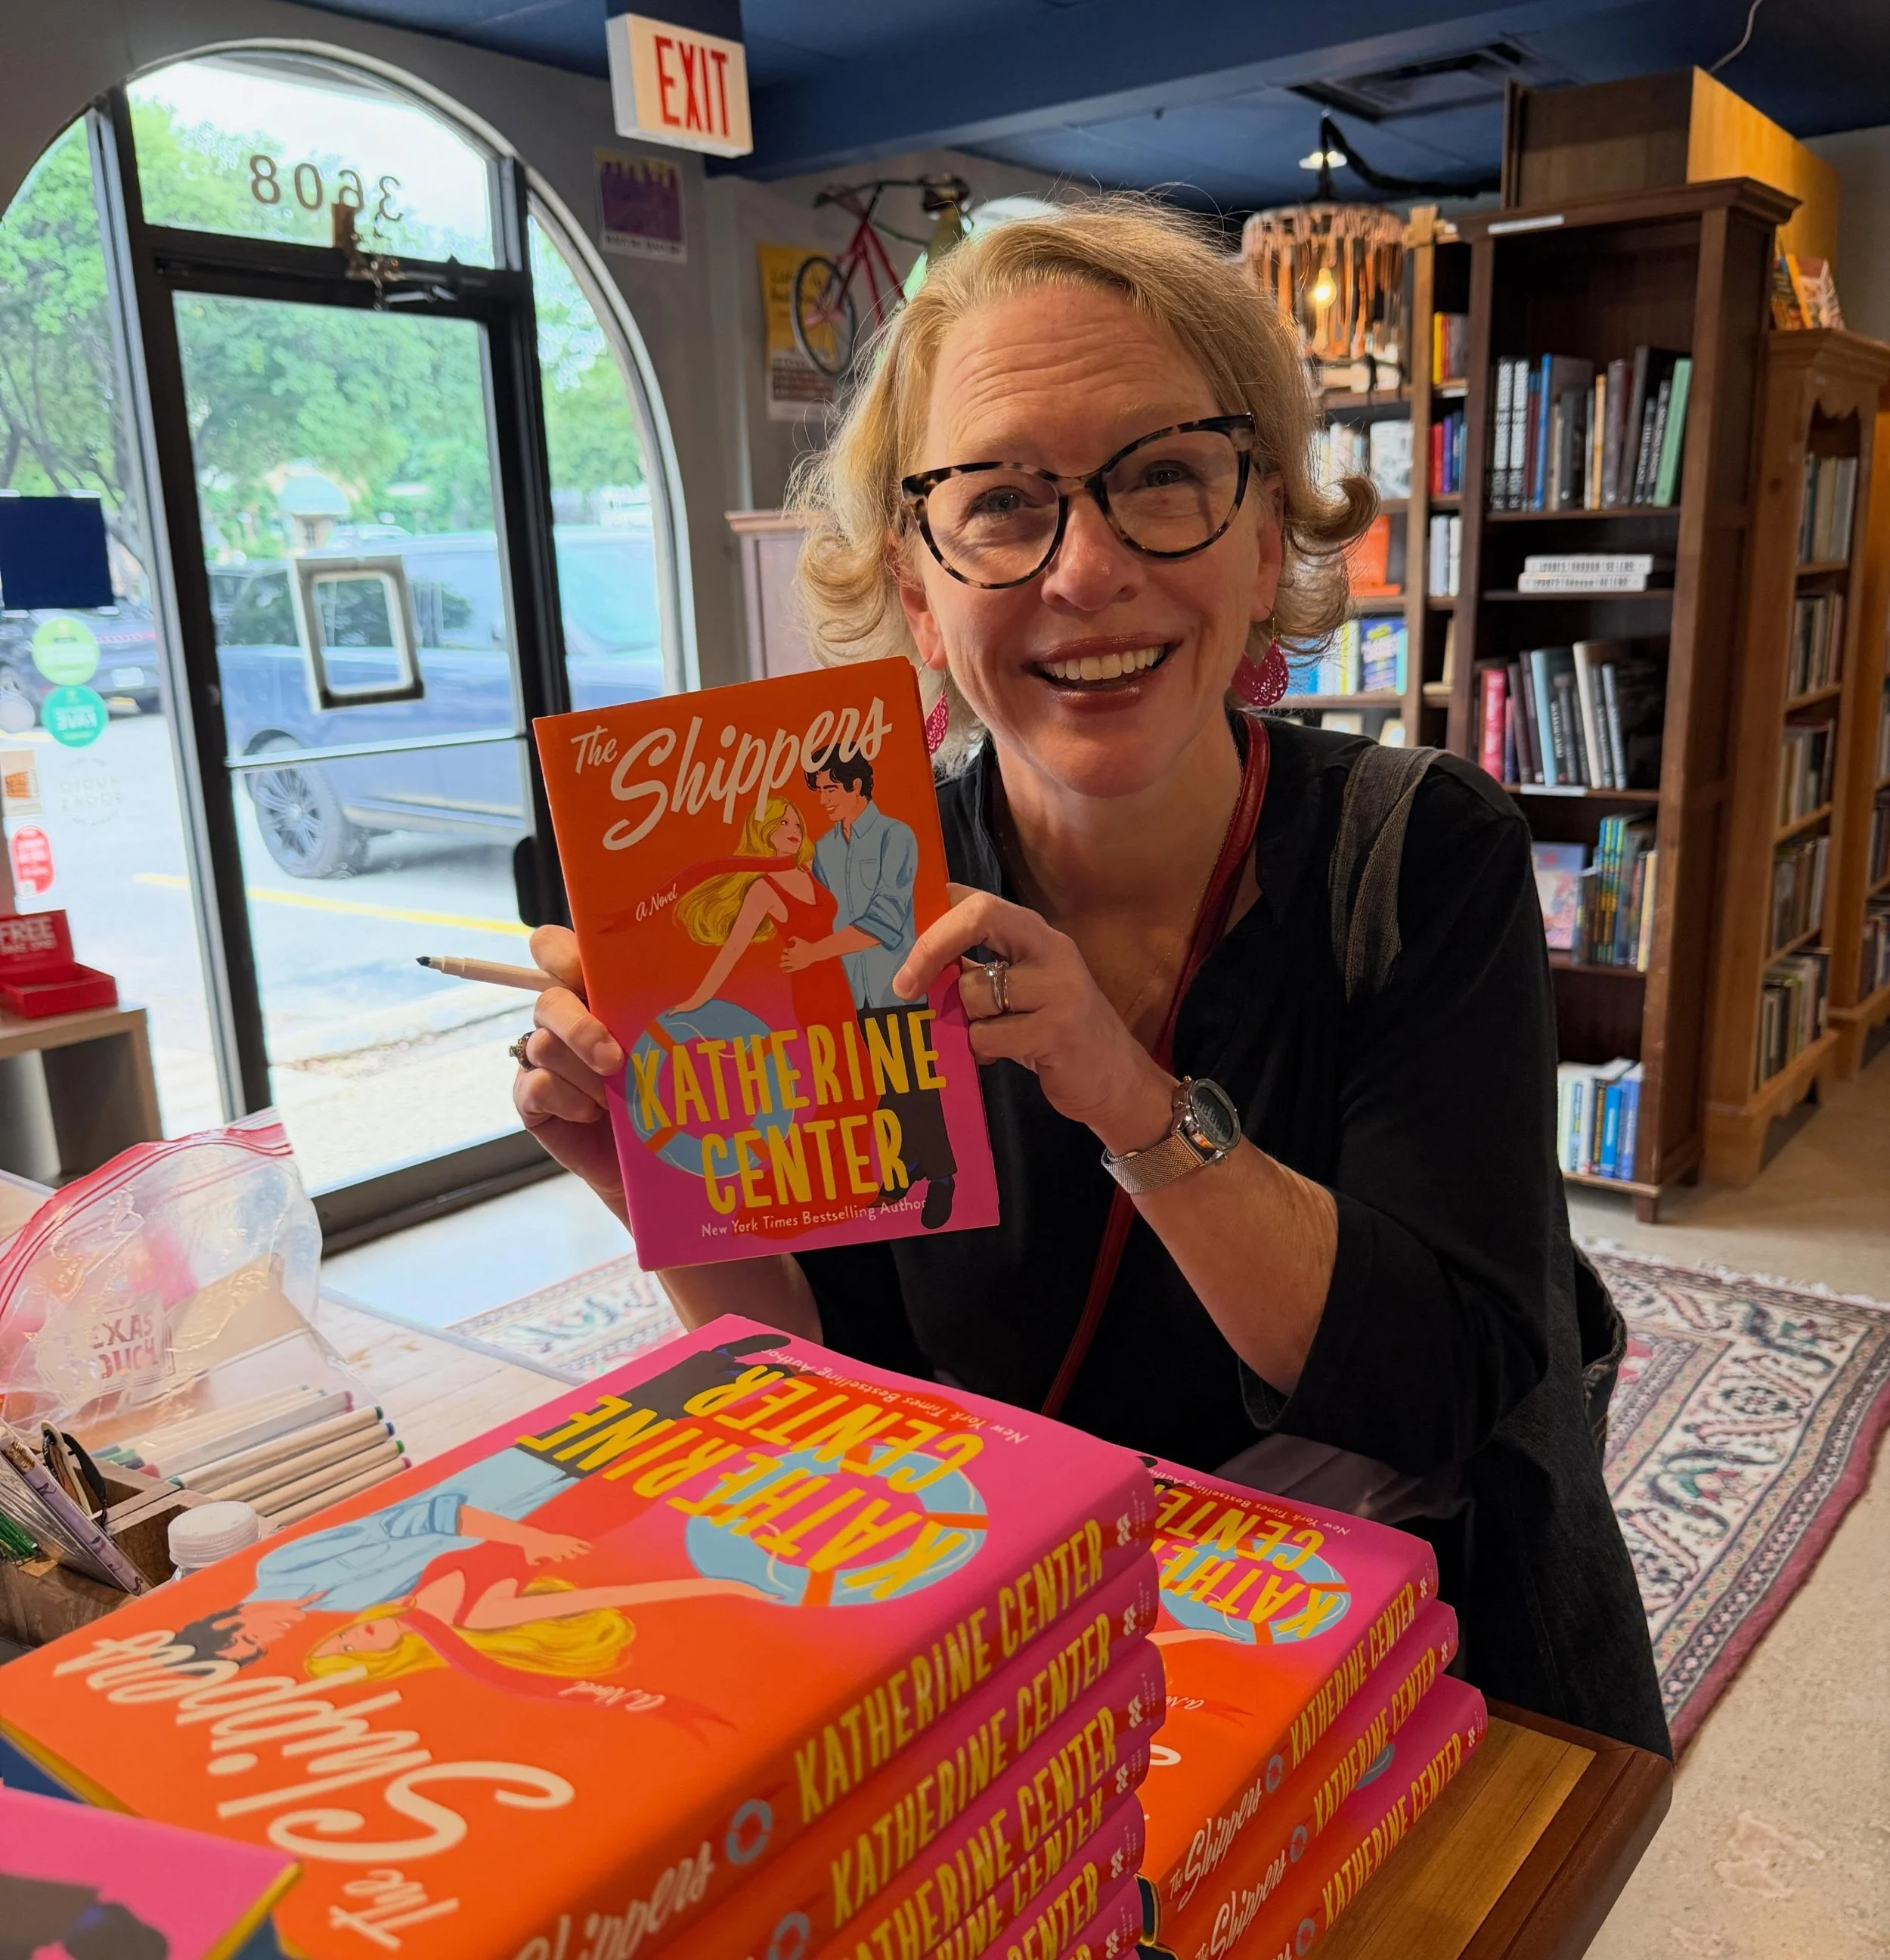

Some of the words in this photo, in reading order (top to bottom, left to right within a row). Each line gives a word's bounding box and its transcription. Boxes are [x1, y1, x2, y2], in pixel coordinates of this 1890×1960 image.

[653, 34, 731, 139] EXIT
[570, 725, 618, 775] The
[602, 696, 893, 851] Shippers
[649, 882, 678, 916] Novel
[632, 1009, 947, 1130] KATHERINE
[701, 1109, 909, 1215] CENTER
[701, 1223, 727, 1237] New
[731, 1219, 758, 1234] York
[762, 1214, 798, 1230] Times
[802, 1205, 876, 1225] Bestselling
[879, 1199, 927, 1215] Author
[761, 1348, 816, 1374] Author
[822, 1366, 901, 1403] Bestselling
[902, 1397, 950, 1419] Times
[683, 1365, 984, 1494] CENTER
[949, 1411, 987, 1431] York
[990, 1423, 1029, 1444] New
[516, 1394, 965, 1602] KATHERINE
[1154, 1484, 1325, 1571] CENTE
[1186, 1480, 1252, 1509] Bestselling
[1255, 1504, 1288, 1519] Times
[1293, 1512, 1319, 1527] York
[1322, 1522, 1351, 1536] New
[1149, 1538, 1340, 1639] KATHE
[795, 1607, 992, 1824] KATHERINE
[999, 1518, 1102, 1658] CENTER
[53, 1630, 575, 1862] Shippers
[832, 1707, 1008, 1929] KATHERINE
[1017, 1612, 1110, 1754] CENTER
[1018, 1706, 1117, 1852] CENTER
[1169, 1867, 1183, 1900] The
[1177, 1778, 1263, 1912] Shippers
[1290, 1639, 1367, 1769] KATHERINE
[1369, 1581, 1415, 1670] CENTER
[1210, 1849, 1287, 1960] Shippers
[1314, 1706, 1390, 1838] KATHERINE
[1392, 1646, 1436, 1736] CENTER
[1321, 1794, 1407, 1931] KATHERINE
[1411, 1732, 1462, 1825] CENTER
[328, 1868, 460, 1951] The
[1007, 1862, 1098, 1960] ENTER
